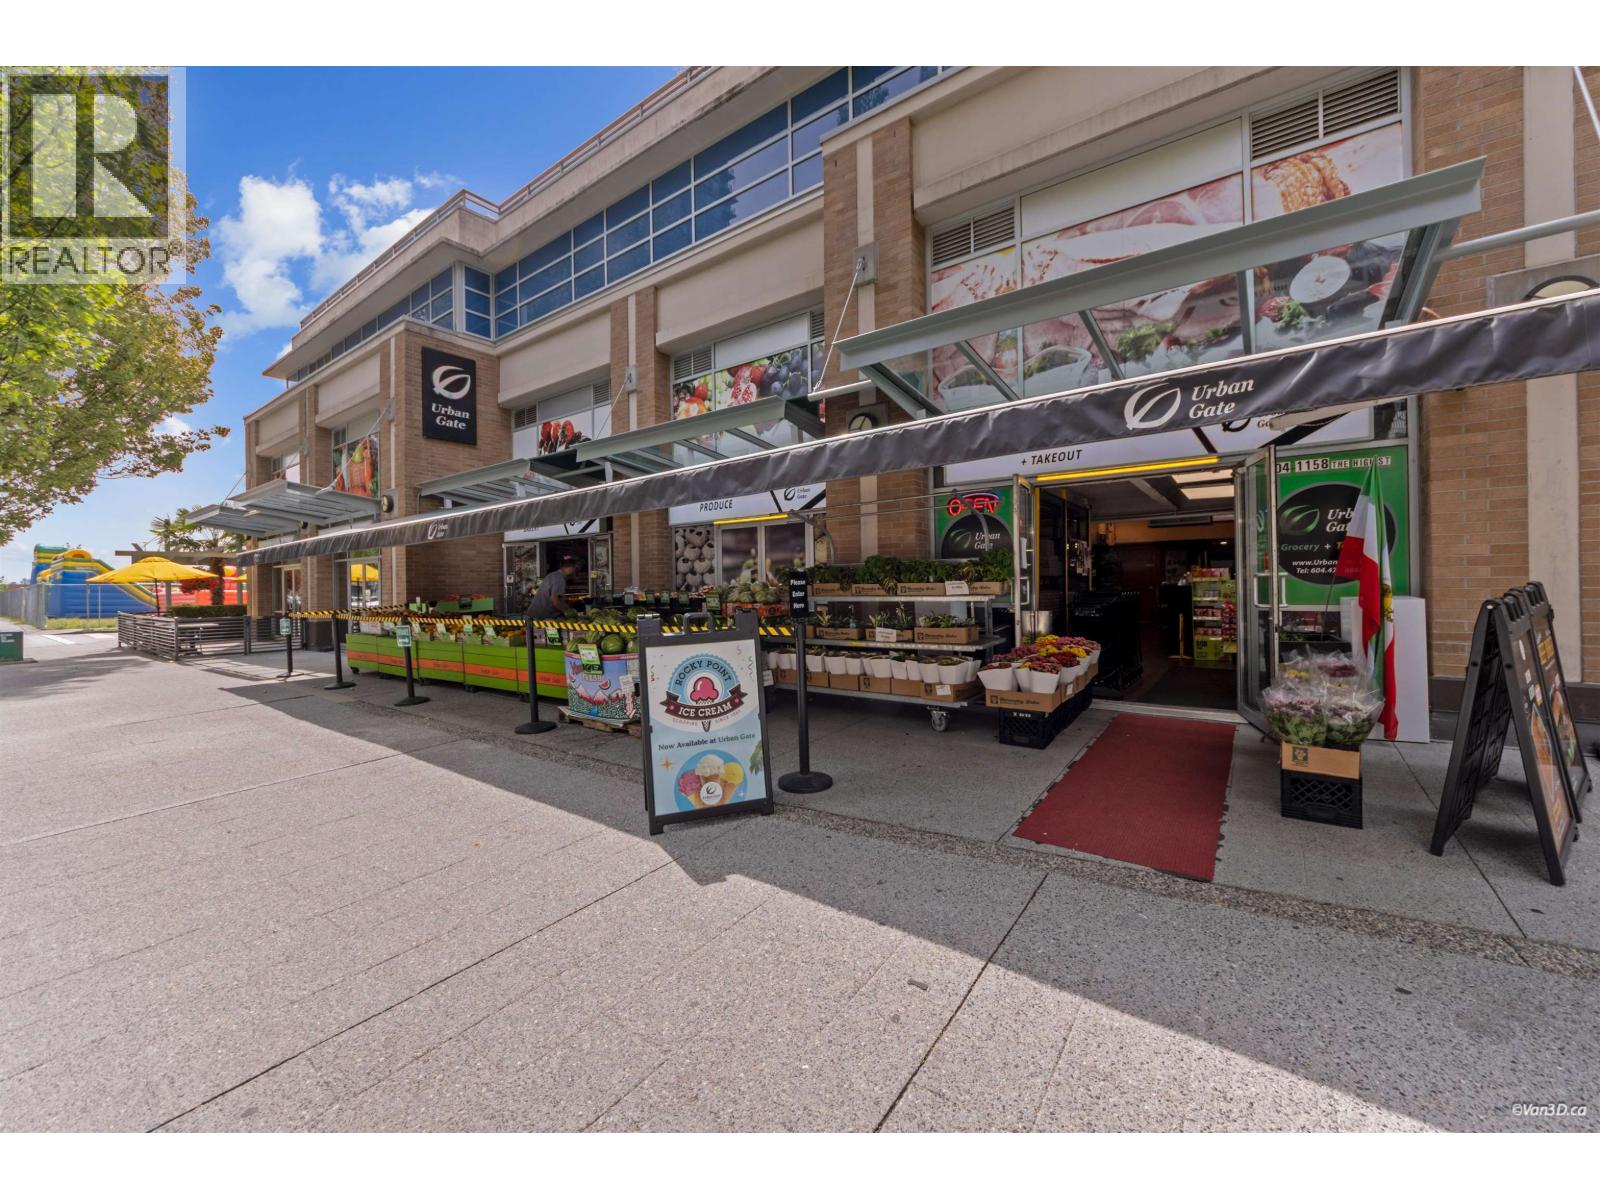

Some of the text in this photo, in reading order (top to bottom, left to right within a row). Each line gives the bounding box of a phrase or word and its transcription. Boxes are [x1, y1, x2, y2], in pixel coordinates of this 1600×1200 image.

[1192, 379, 1254, 401] Urban
[432, 403, 470, 419] Urban
[1189, 402, 1236, 419] Gate
[436, 416, 466, 430] Gate
[1031, 449, 1083, 465] TAKEOUT
[1297, 458, 1329, 471] 1158
[1378, 456, 1391, 465] ST
[699, 499, 733, 512] PRODUCE
[1281, 543, 1320, 552] Grocery
[675, 660, 732, 686] ROCKY POINT
[678, 707, 695, 717] ICE
[698, 702, 733, 717] CREAM
[676, 739, 709, 749] Available
[740, 732, 756, 740] Gate
